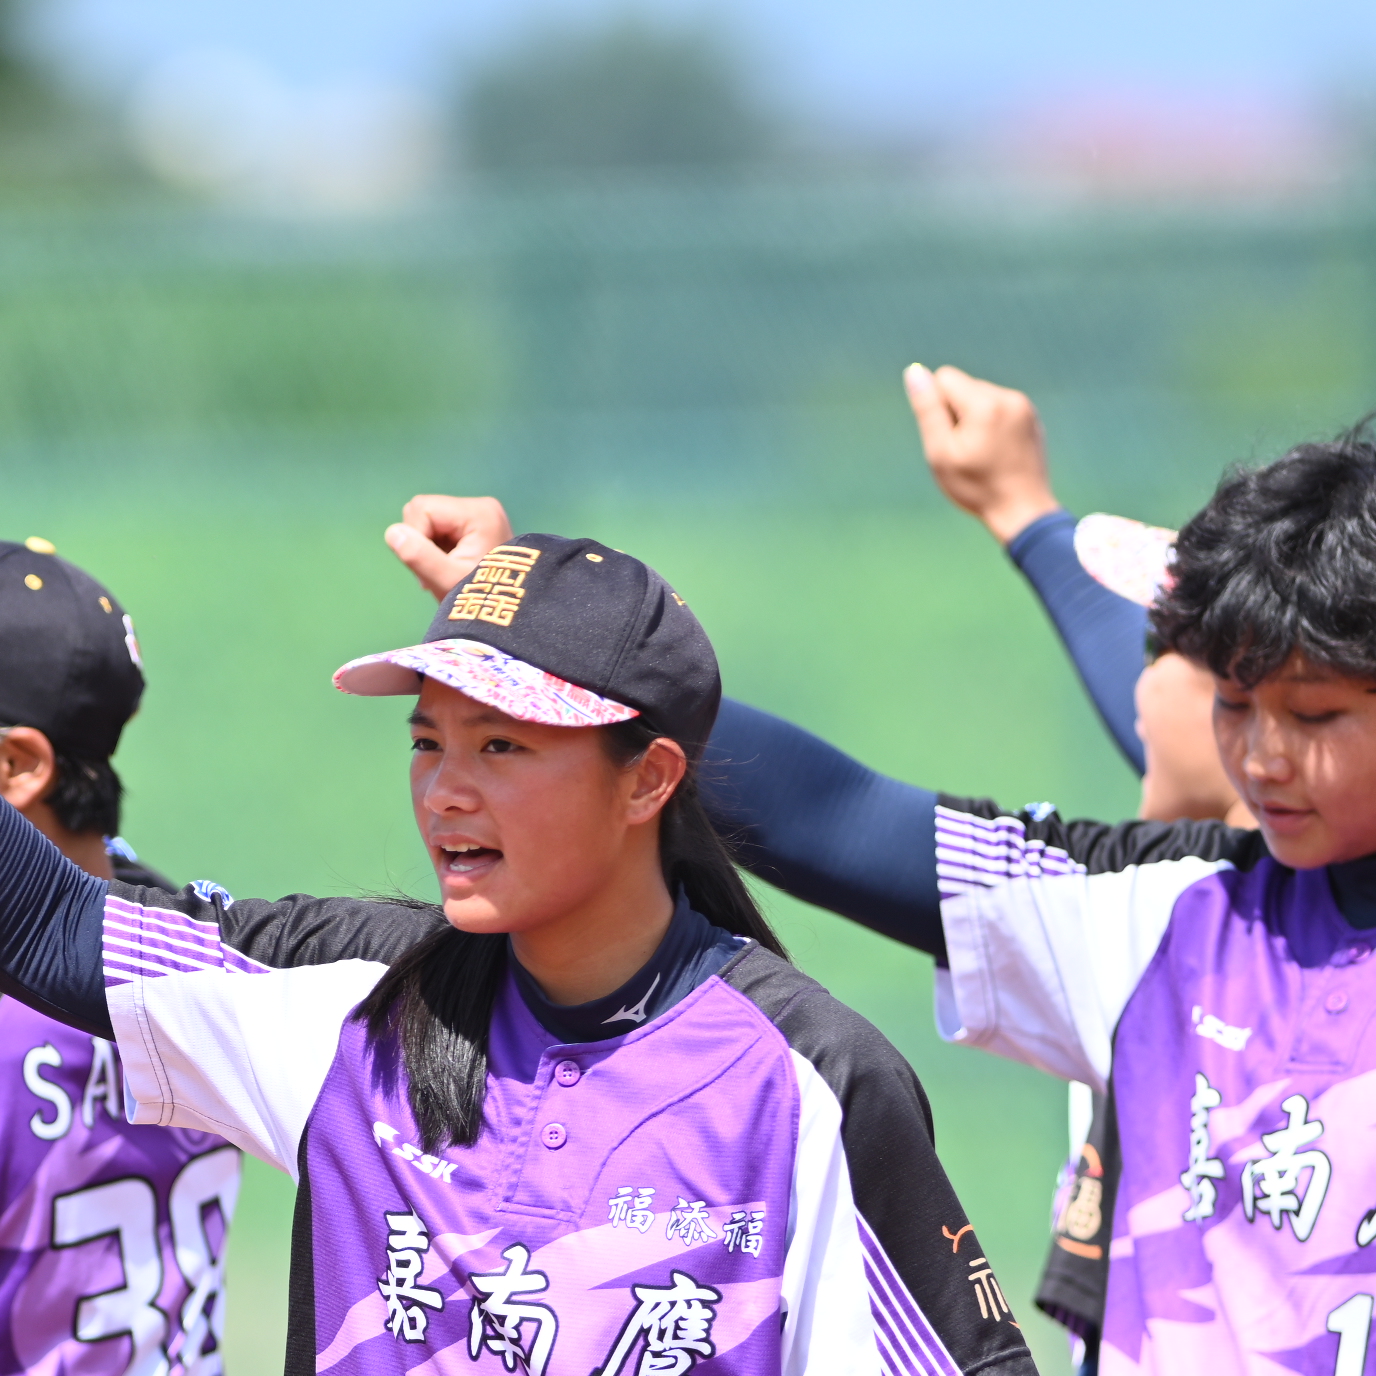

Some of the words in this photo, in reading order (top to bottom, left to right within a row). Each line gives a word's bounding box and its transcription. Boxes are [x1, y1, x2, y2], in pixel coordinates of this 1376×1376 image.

[472, 567, 526, 588] PULI
[392, 1143, 458, 1183] SSK
[607, 1186, 766, 1260] 福添福
